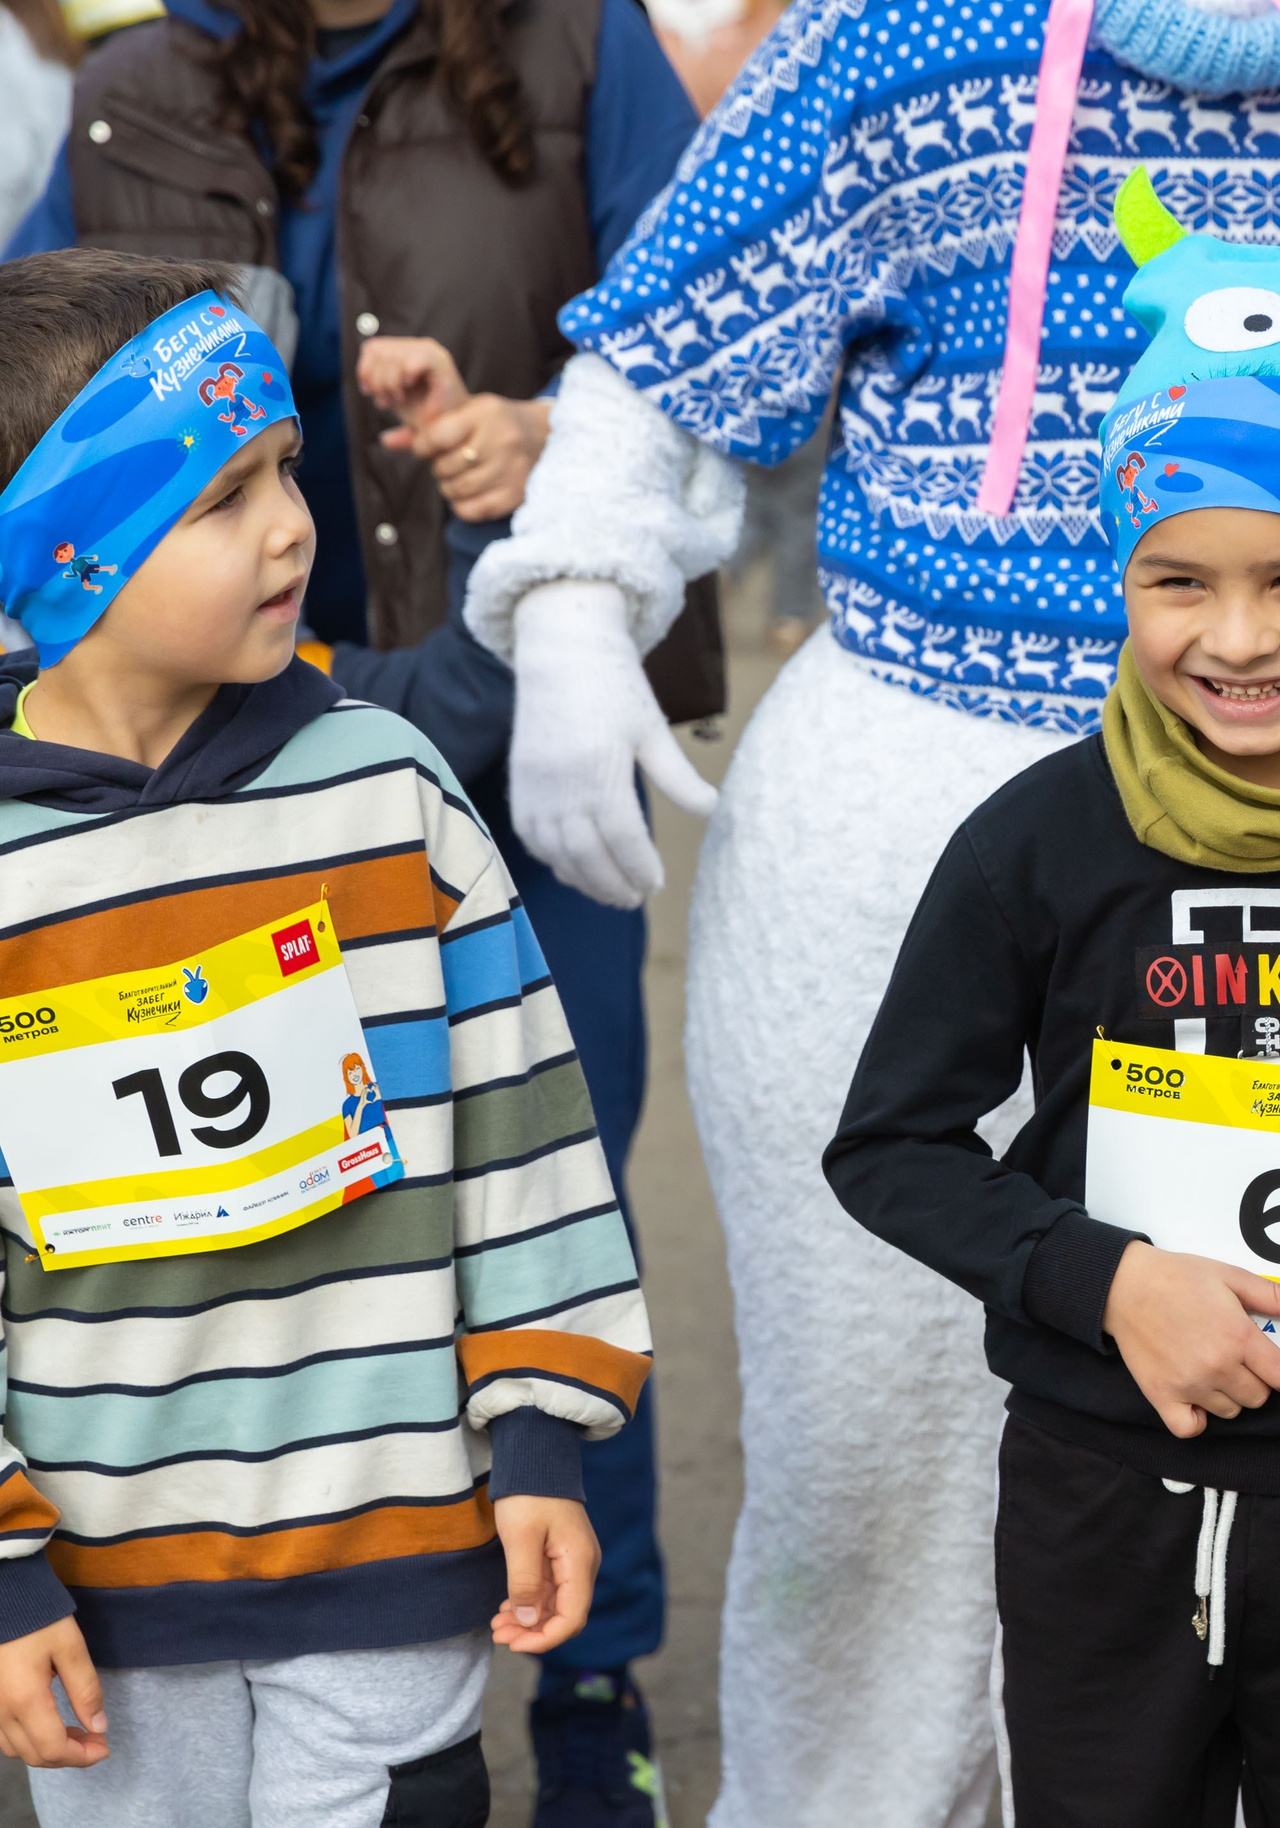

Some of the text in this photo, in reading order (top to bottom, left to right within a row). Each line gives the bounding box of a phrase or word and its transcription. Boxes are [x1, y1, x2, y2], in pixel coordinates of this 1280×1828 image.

[280, 934, 310, 962] SPLAT
[136, 992, 166, 1007] ЗАБЕГ
[0, 1007, 56, 1034] 500
[3, 1025, 59, 1044] метров
[1126, 1062, 1185, 1088] 500
[1126, 1083, 1182, 1100] метров
[111, 1050, 271, 1158] 19
[122, 1213, 163, 1227] centre
